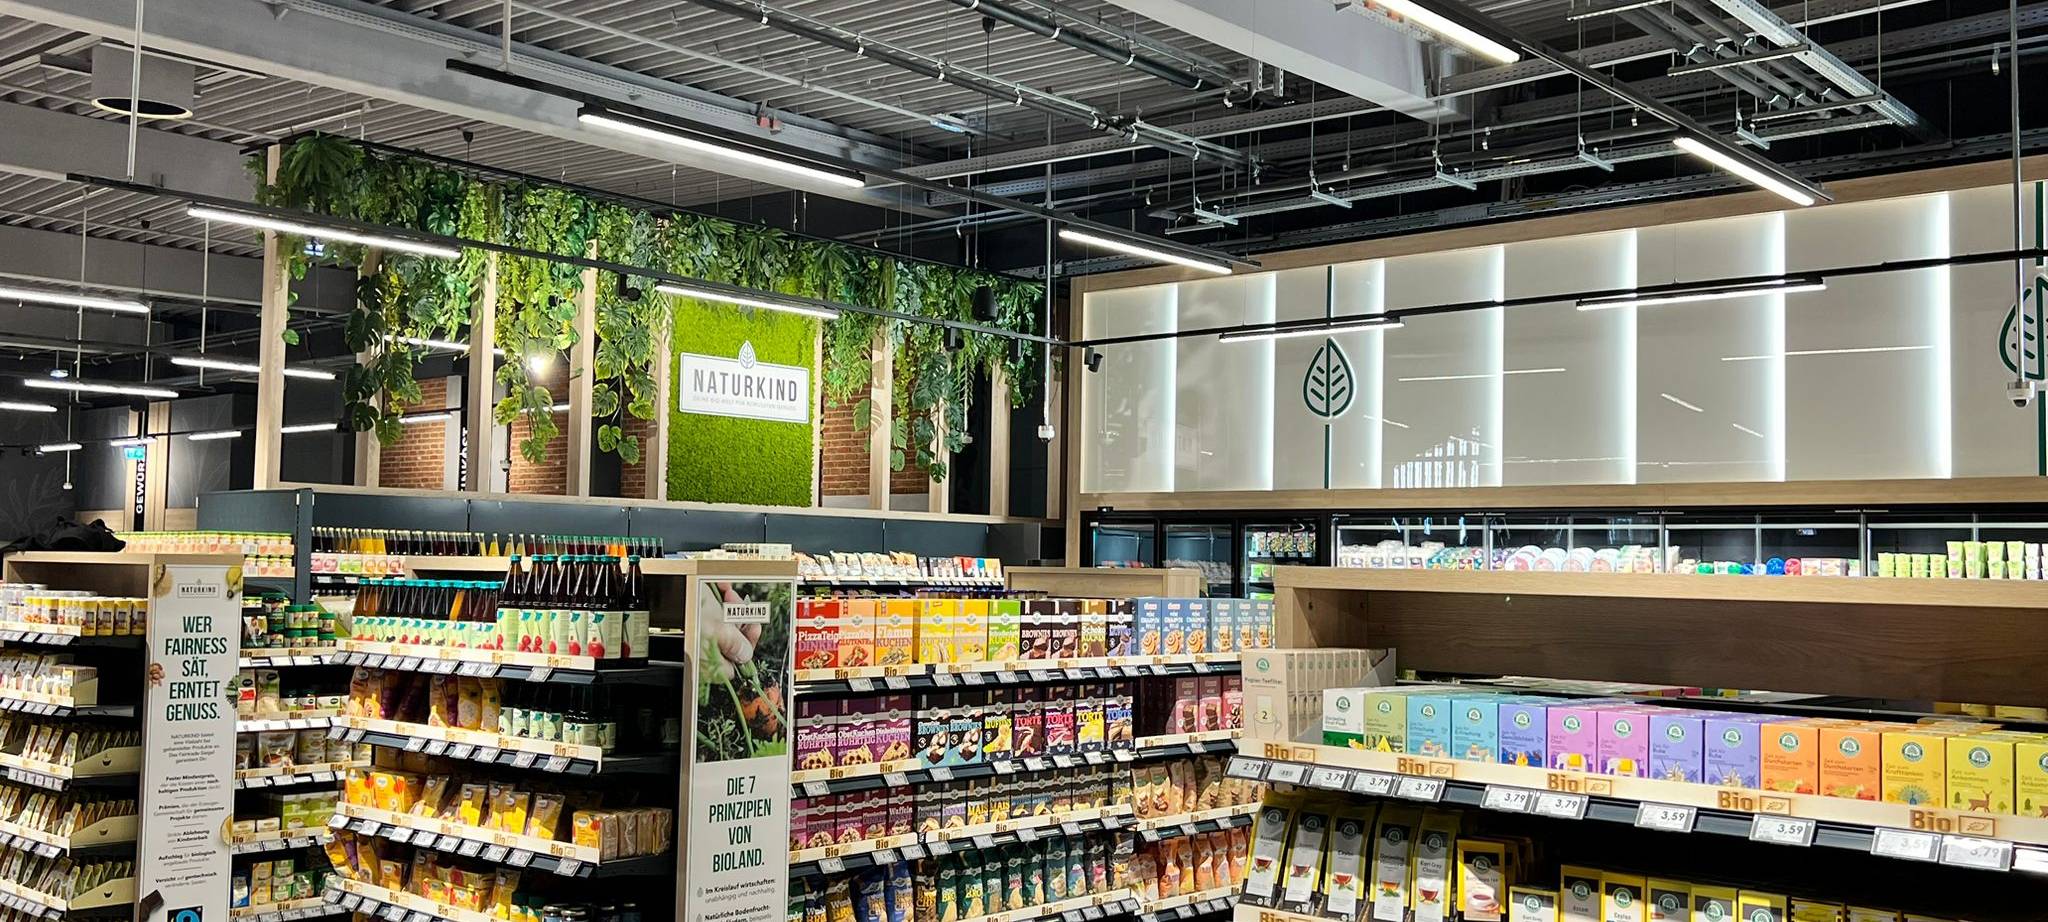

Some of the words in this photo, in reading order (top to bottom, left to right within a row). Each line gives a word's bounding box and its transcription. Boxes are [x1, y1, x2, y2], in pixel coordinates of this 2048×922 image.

[694, 368, 797, 401] NATURKIND
[181, 586, 217, 594] NATURKIND
[727, 606, 767, 616] NATURKIND
[182, 616, 212, 633] WER
[798, 630, 839, 643] PizzaTeig
[876, 637, 912, 648] KUCHEN
[165, 637, 227, 656] FAIRNESS
[182, 656, 209, 678] SÄT,
[884, 667, 897, 676] Bio
[835, 670, 848, 679] Bio
[169, 681, 220, 700] ERNTET
[166, 703, 221, 722] GENUSS.
[1046, 713, 1074, 724] TORTE
[1077, 711, 1104, 721] TORTE
[1107, 709, 1132, 720] TORTE
[1262, 710, 1268, 720] 2
[1015, 715, 1042, 727] TORTE
[1264, 743, 1289, 760] Bio
[880, 761, 893, 772] Bio
[1397, 757, 1425, 775] Bio
[830, 769, 844, 778] Bio
[727, 777, 745, 796] DIE
[748, 776, 756, 794] 7
[1547, 773, 1578, 792] Bio
[1504, 792, 1526, 803] 3,79
[1718, 790, 1754, 811] Bio
[709, 798, 771, 823] PRINZIPIEN
[1555, 799, 1578, 810] 3,79
[1661, 811, 1685, 821] 3,59
[1910, 810, 1951, 832] Bio
[1778, 823, 1804, 835] 3,59
[728, 825, 752, 846] VON
[551, 844, 563, 855] Bio
[876, 840, 889, 849] Bio
[825, 847, 839, 857] Bio
[712, 848, 765, 873] BIOLAND.
